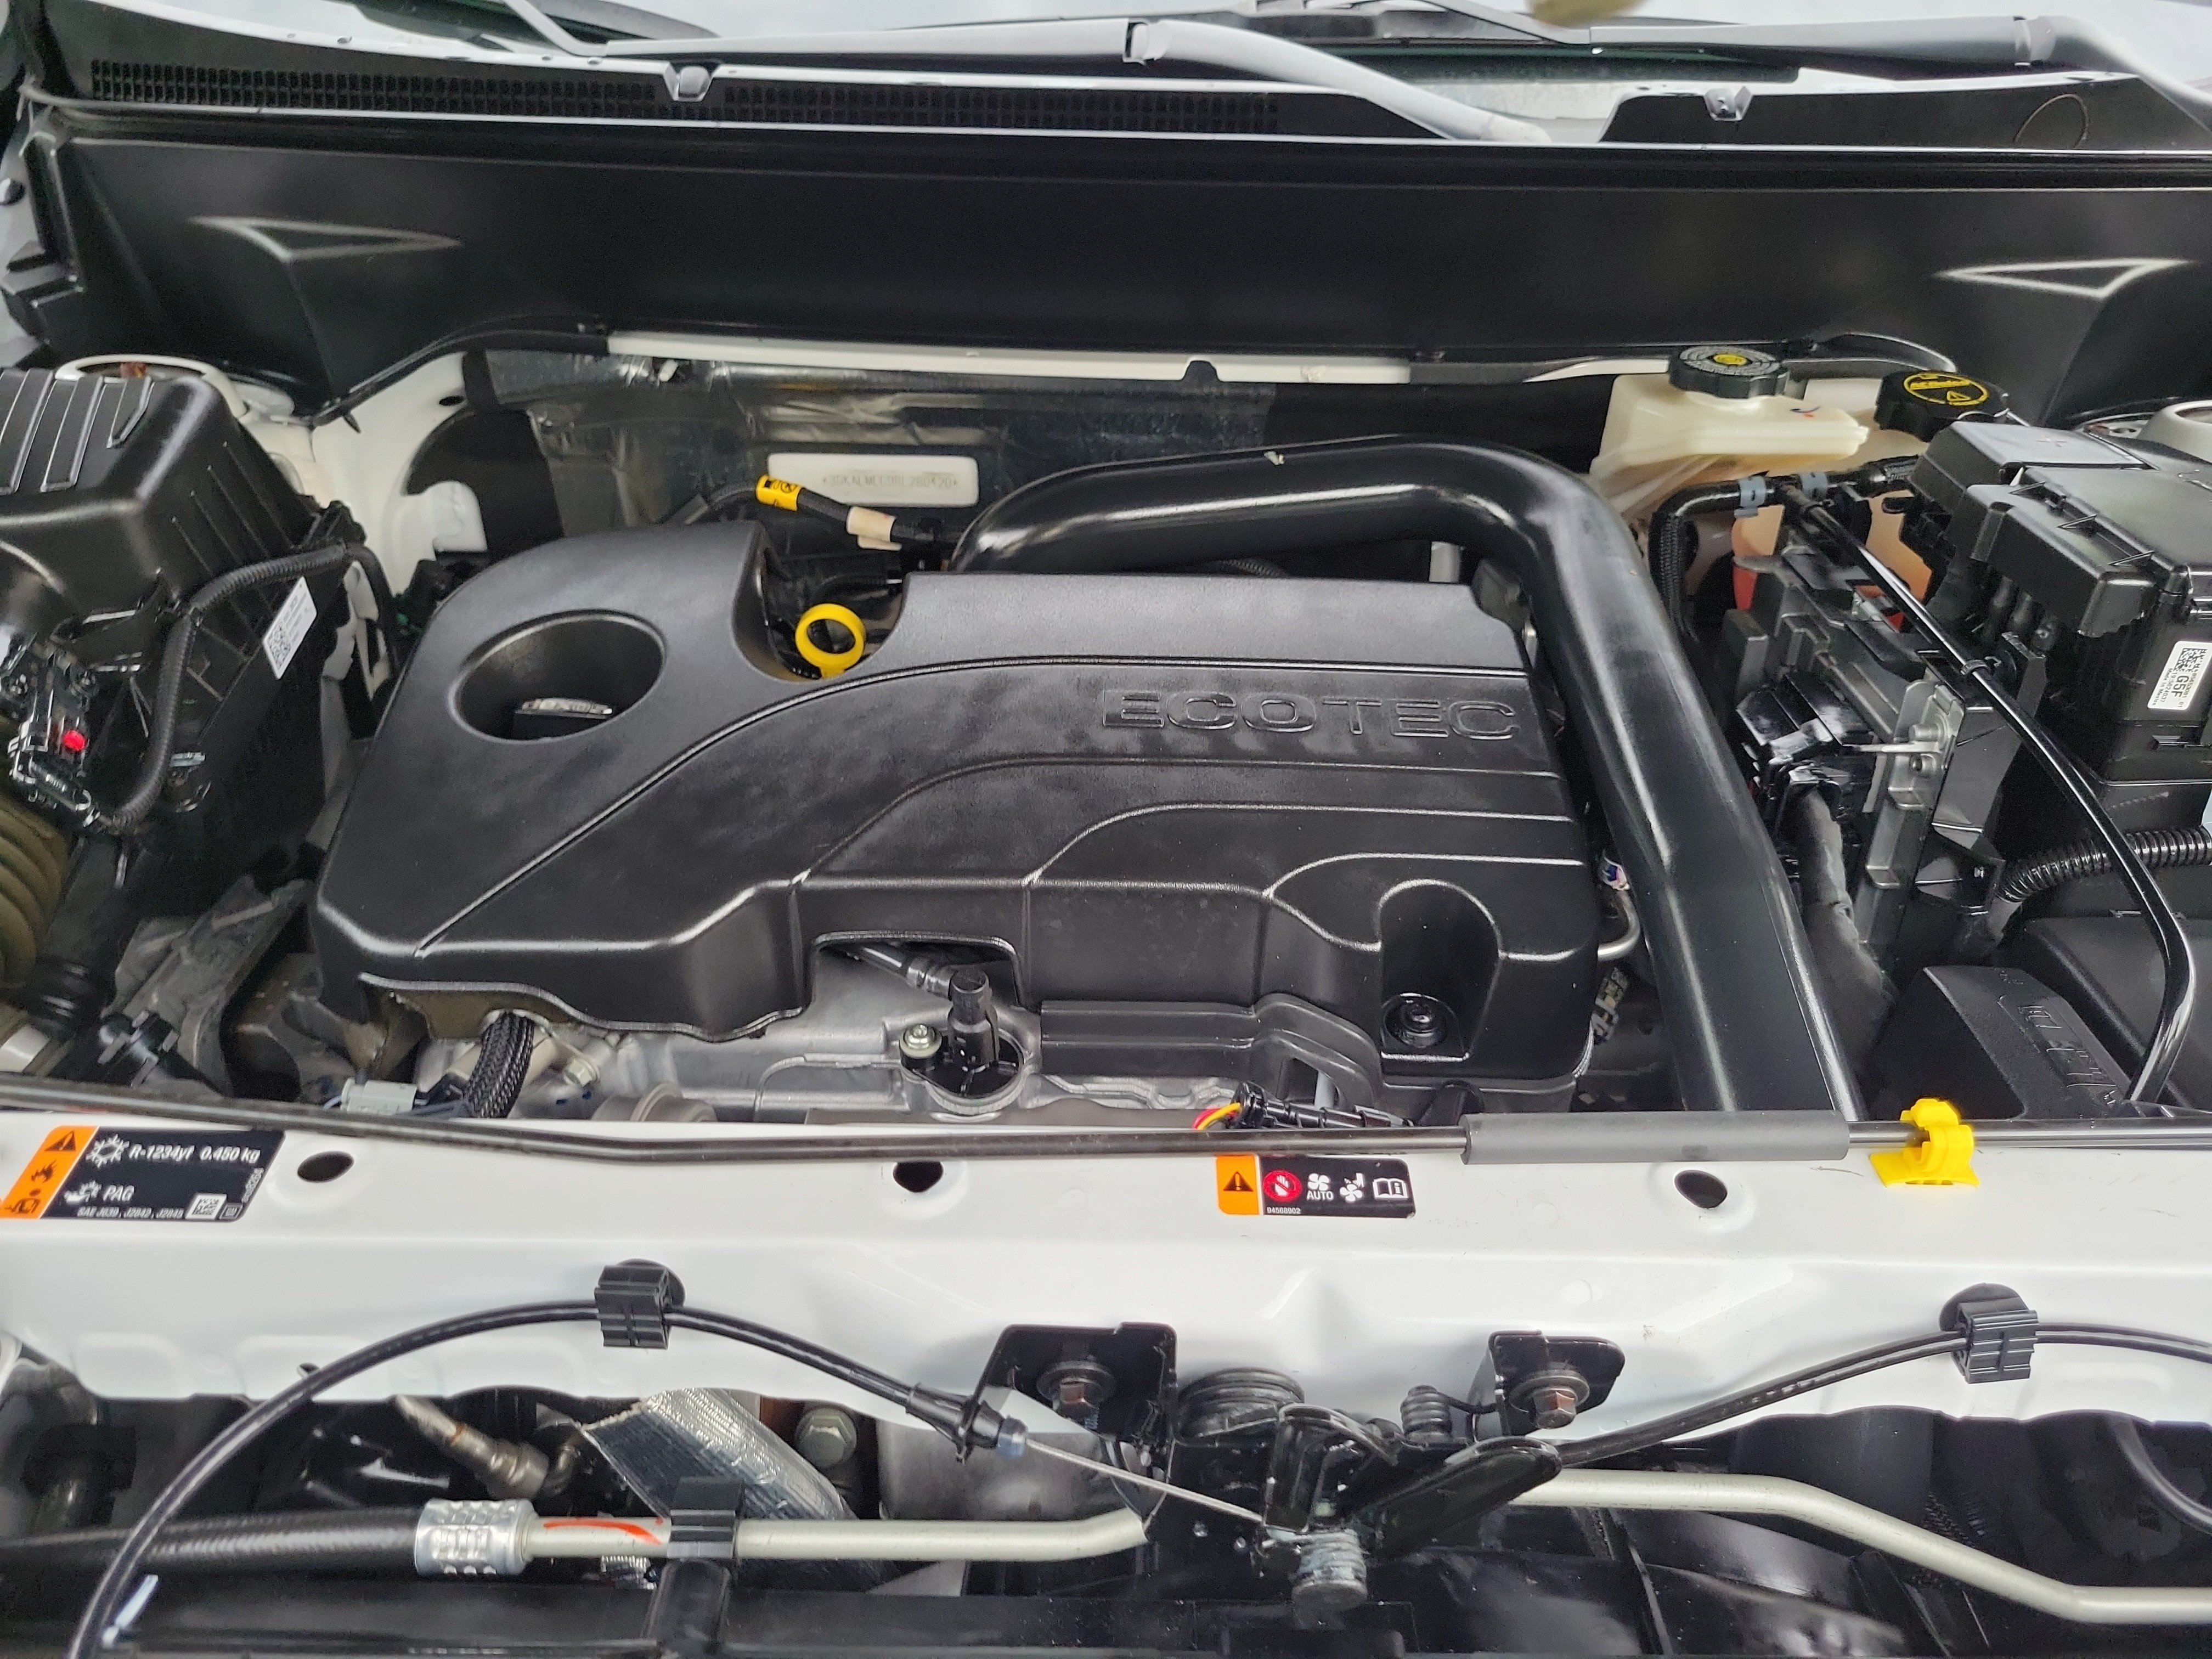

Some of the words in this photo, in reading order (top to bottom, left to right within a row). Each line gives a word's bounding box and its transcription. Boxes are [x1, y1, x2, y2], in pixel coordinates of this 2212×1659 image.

[1103, 689, 1519, 740] ECOTEC
[129, 1144, 194, 1161] R-1234yf
[240, 1147, 261, 1164] kg
[102, 1185, 135, 1201] PAG
[1307, 1190, 1334, 1201] AUTO
